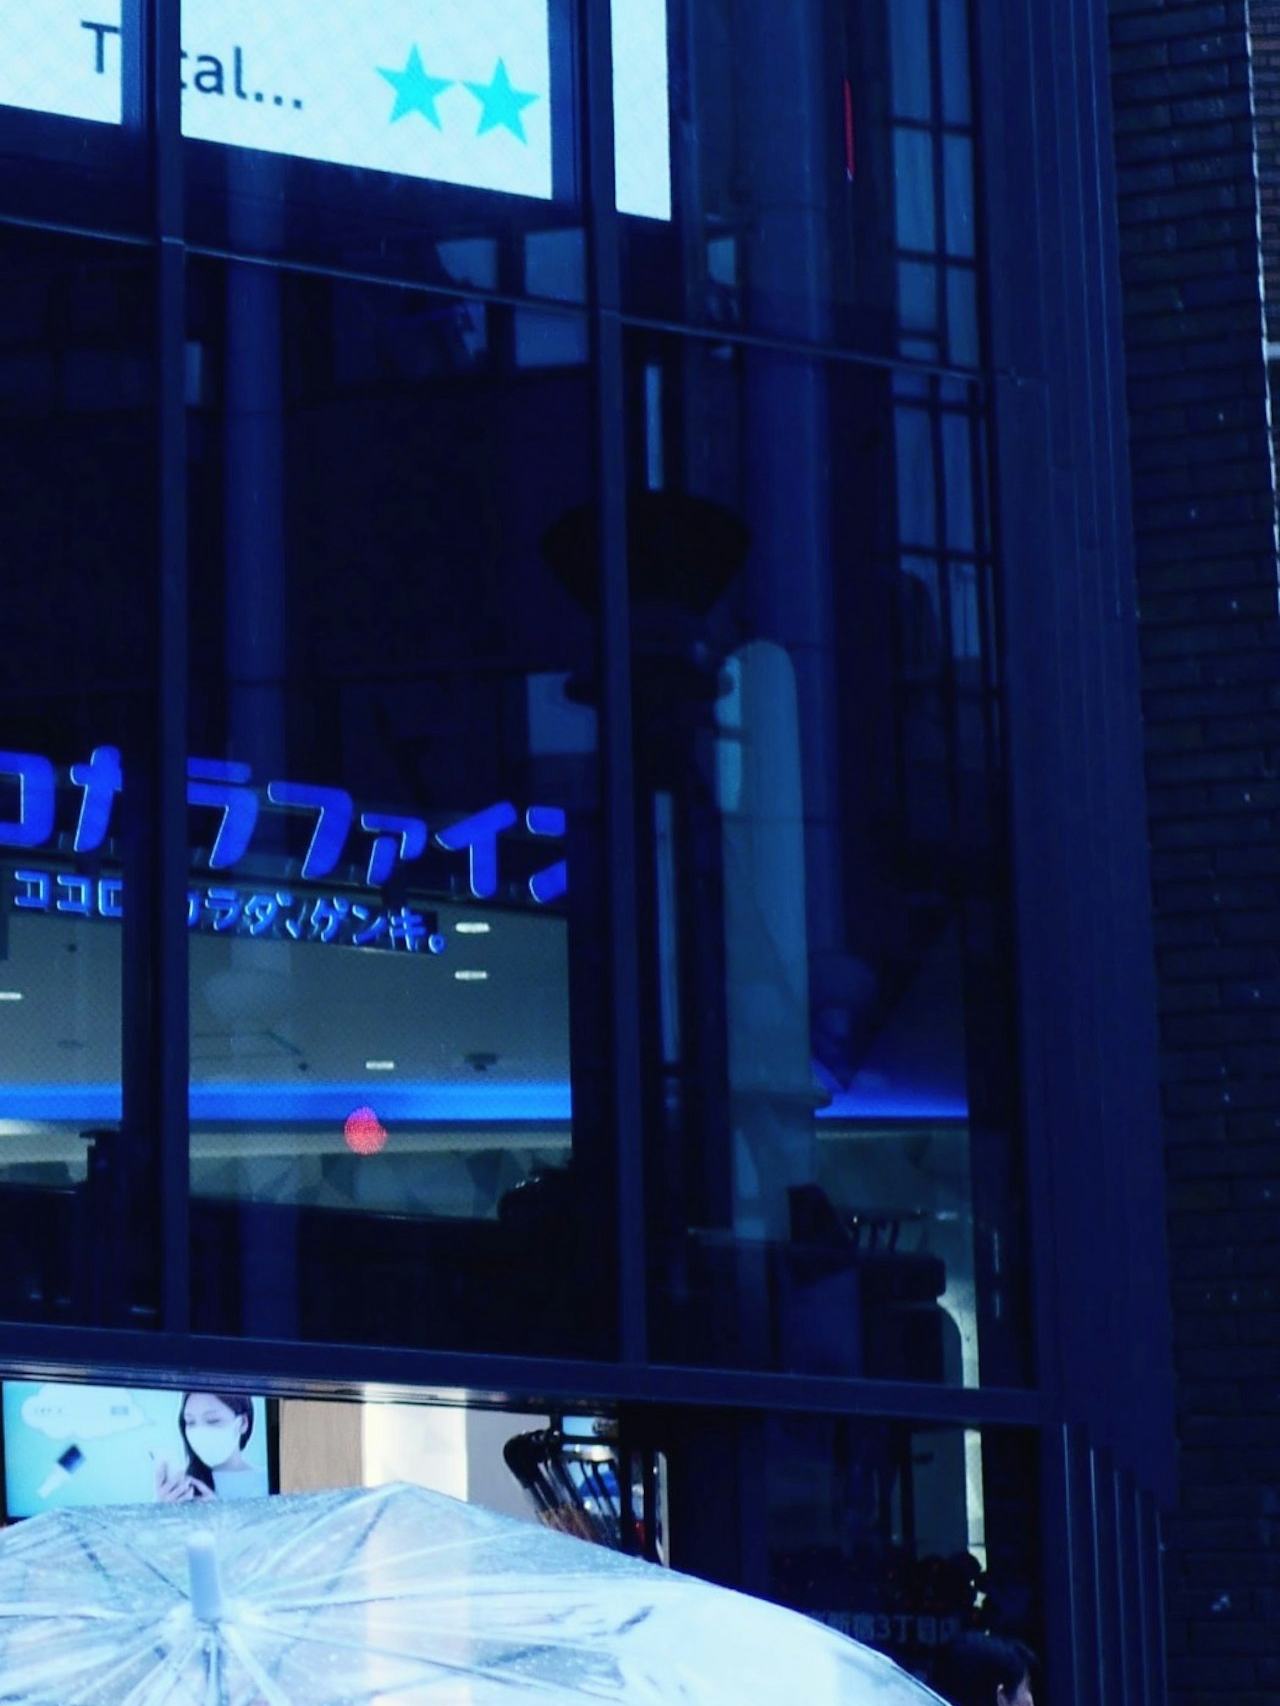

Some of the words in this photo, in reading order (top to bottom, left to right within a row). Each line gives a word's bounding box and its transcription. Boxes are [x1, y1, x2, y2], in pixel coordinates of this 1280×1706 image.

[80, 20, 303, 110] Tal...
[12, 869, 448, 956] ココロラダ、ゲンキ。
